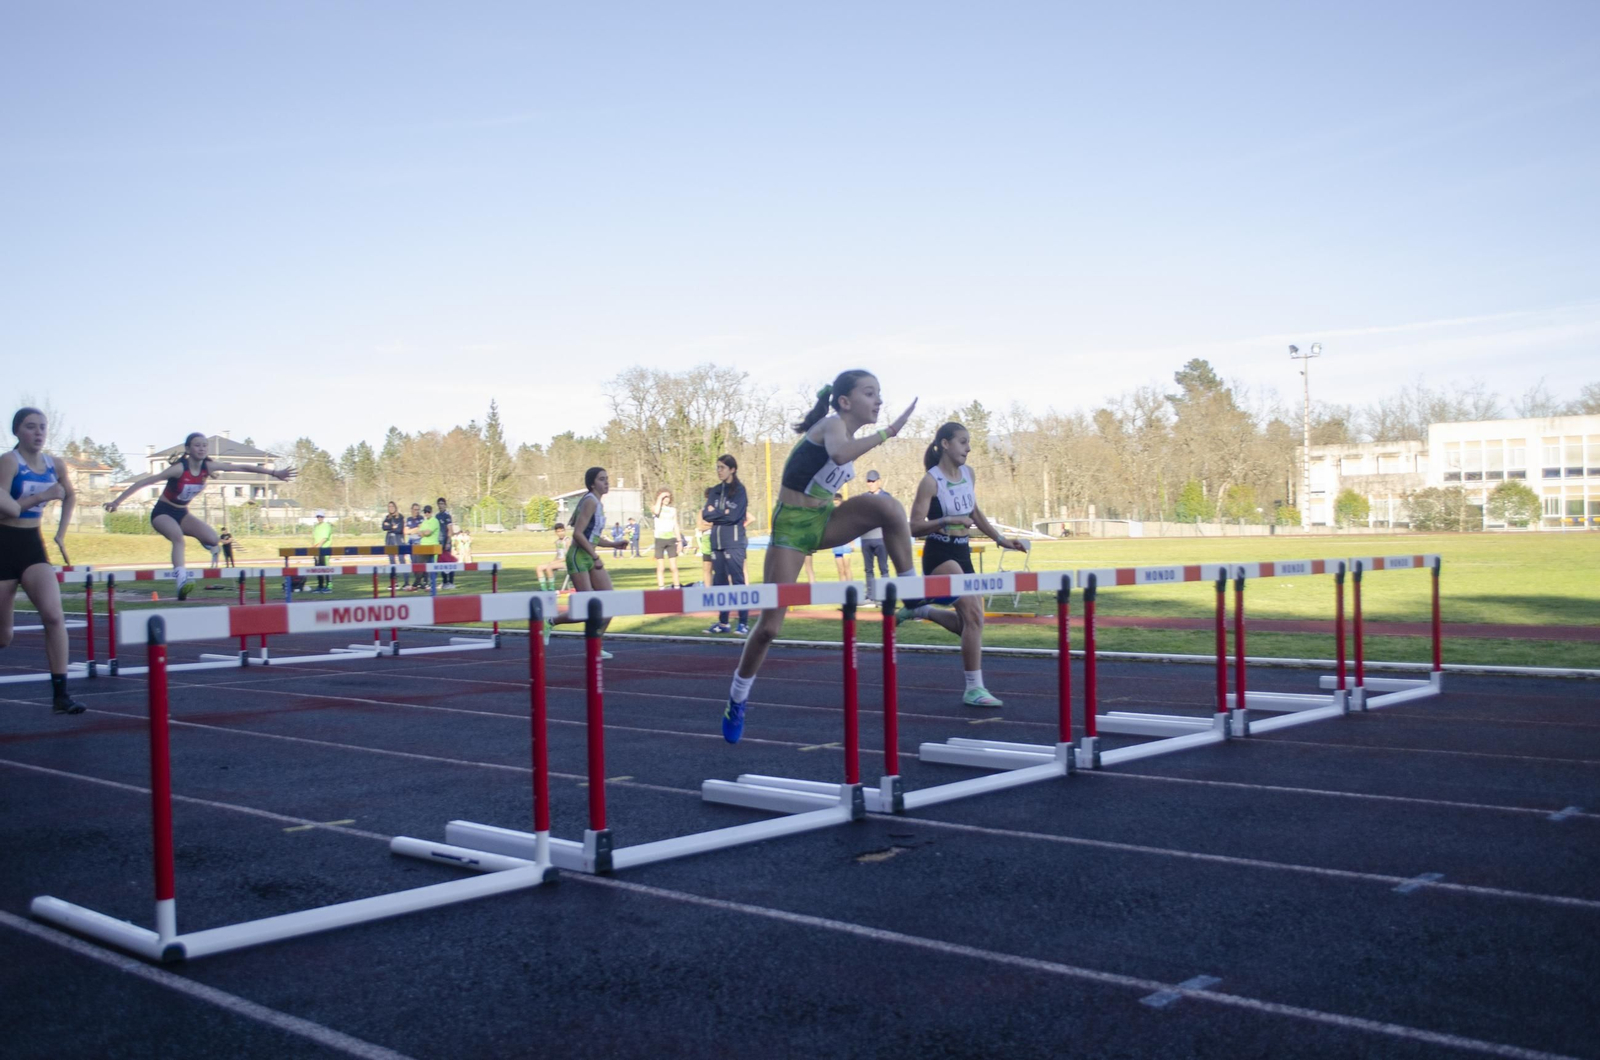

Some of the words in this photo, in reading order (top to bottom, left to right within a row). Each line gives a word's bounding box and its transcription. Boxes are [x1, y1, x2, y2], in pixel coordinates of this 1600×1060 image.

[953, 493, 973, 512] 648
[929, 532, 950, 542] PRO
[1145, 569, 1174, 581] MONDO
[963, 577, 1003, 591] MONDO
[702, 590, 760, 607] MONDO
[332, 604, 409, 624] MONDO
